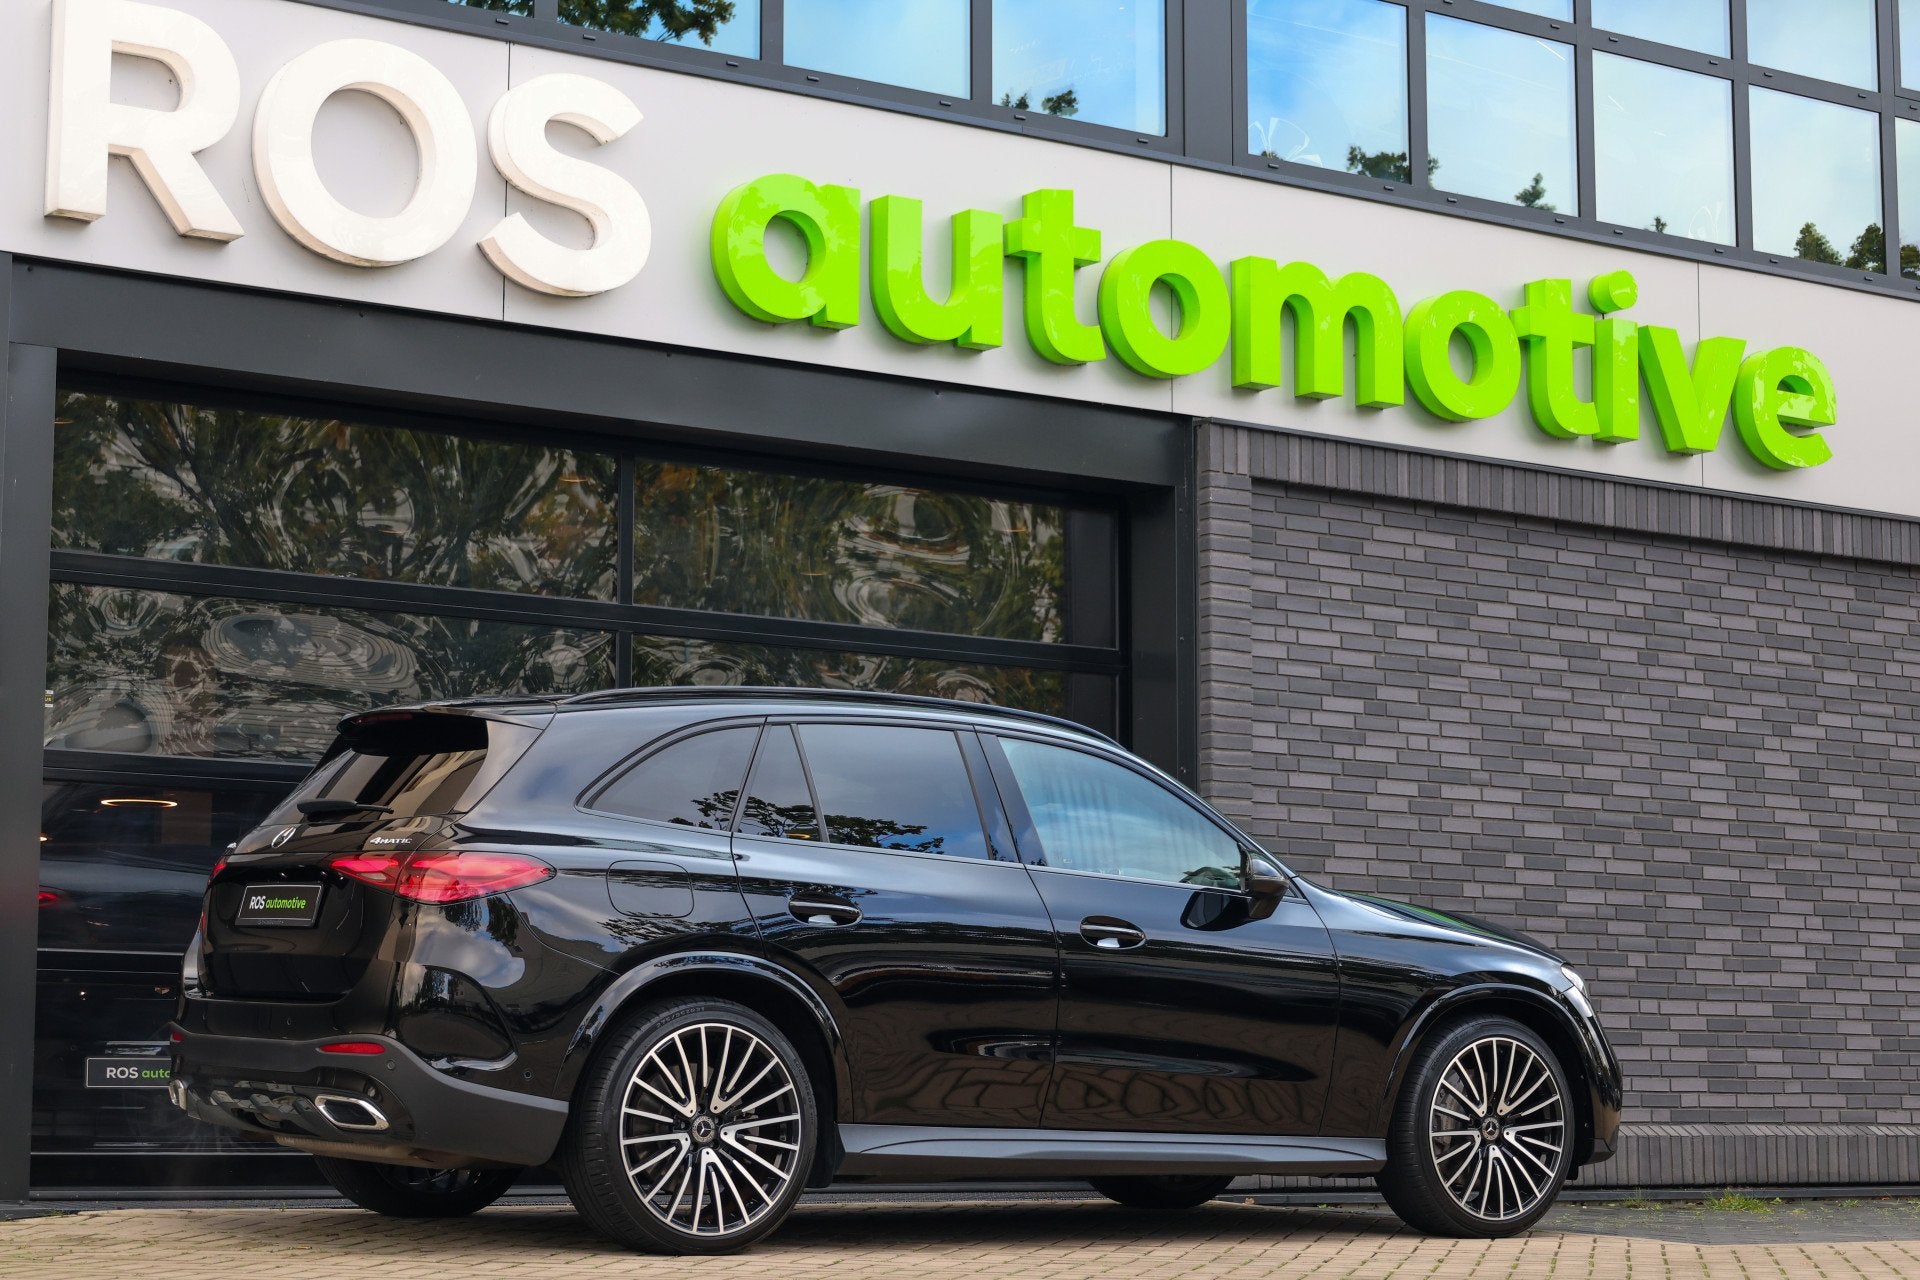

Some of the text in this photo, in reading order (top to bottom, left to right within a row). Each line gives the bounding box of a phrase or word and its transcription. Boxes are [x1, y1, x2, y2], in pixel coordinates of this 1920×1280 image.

[44, 0, 1837, 471] ROS automotive
[249, 896, 306, 909] ROS automotive
[106, 1067, 139, 1079] ROS
